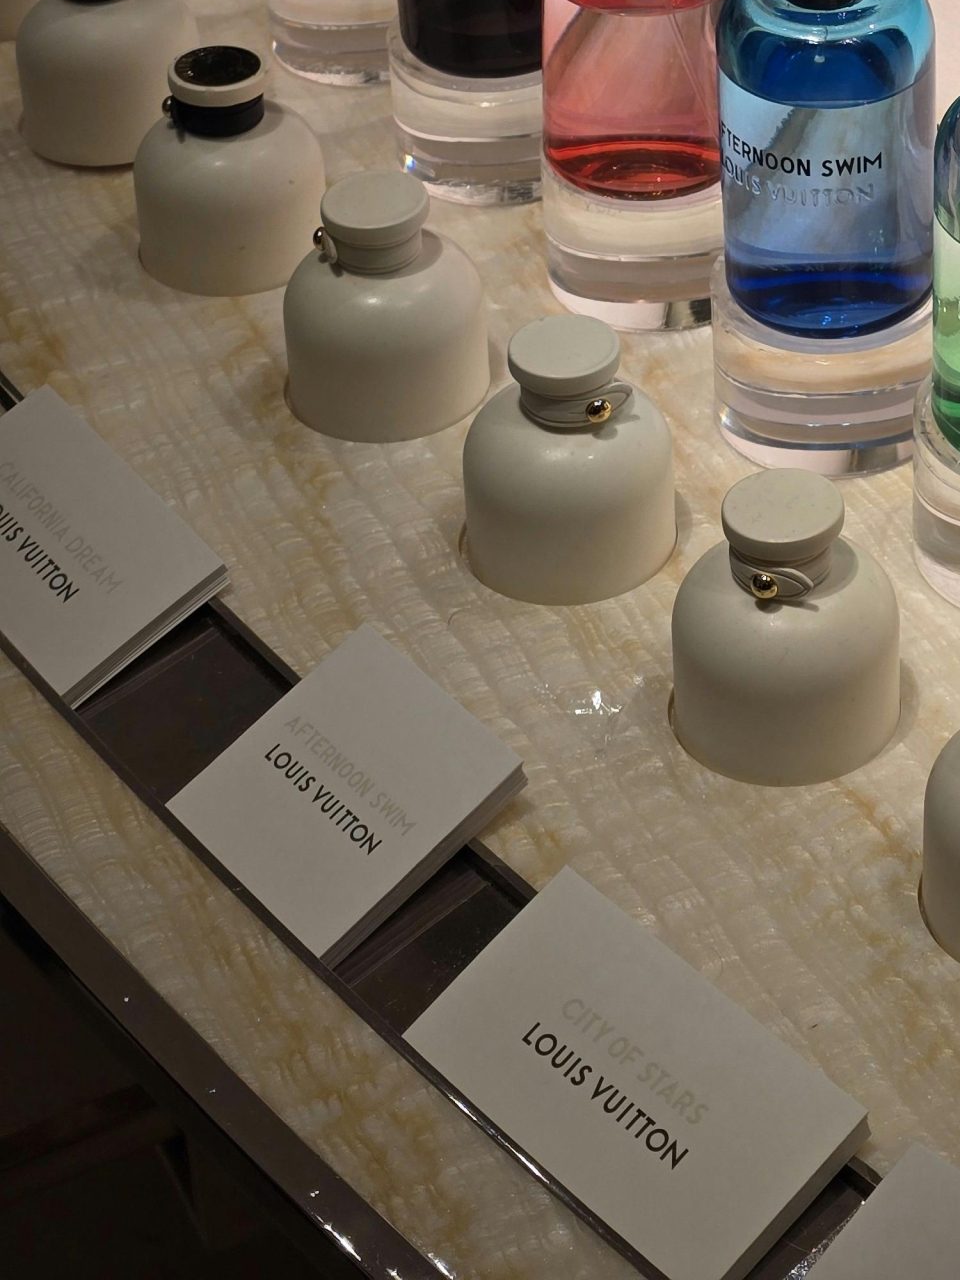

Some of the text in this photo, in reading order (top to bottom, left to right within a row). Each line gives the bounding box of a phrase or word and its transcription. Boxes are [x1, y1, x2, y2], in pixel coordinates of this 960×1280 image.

[721, 121, 883, 177] FTERNOON SWIM
[766, 180, 874, 207] VUITTON
[0, 461, 124, 594] CALIFORNIA DREAM
[16, 535, 80, 603] VUITTON
[264, 743, 383, 856] LOUIS VUITTON
[283, 716, 417, 837] AFTERNOON SWIM
[521, 1021, 689, 1170] LOUIS VUITTON
[561, 998, 710, 1125] CITY OF STARS
